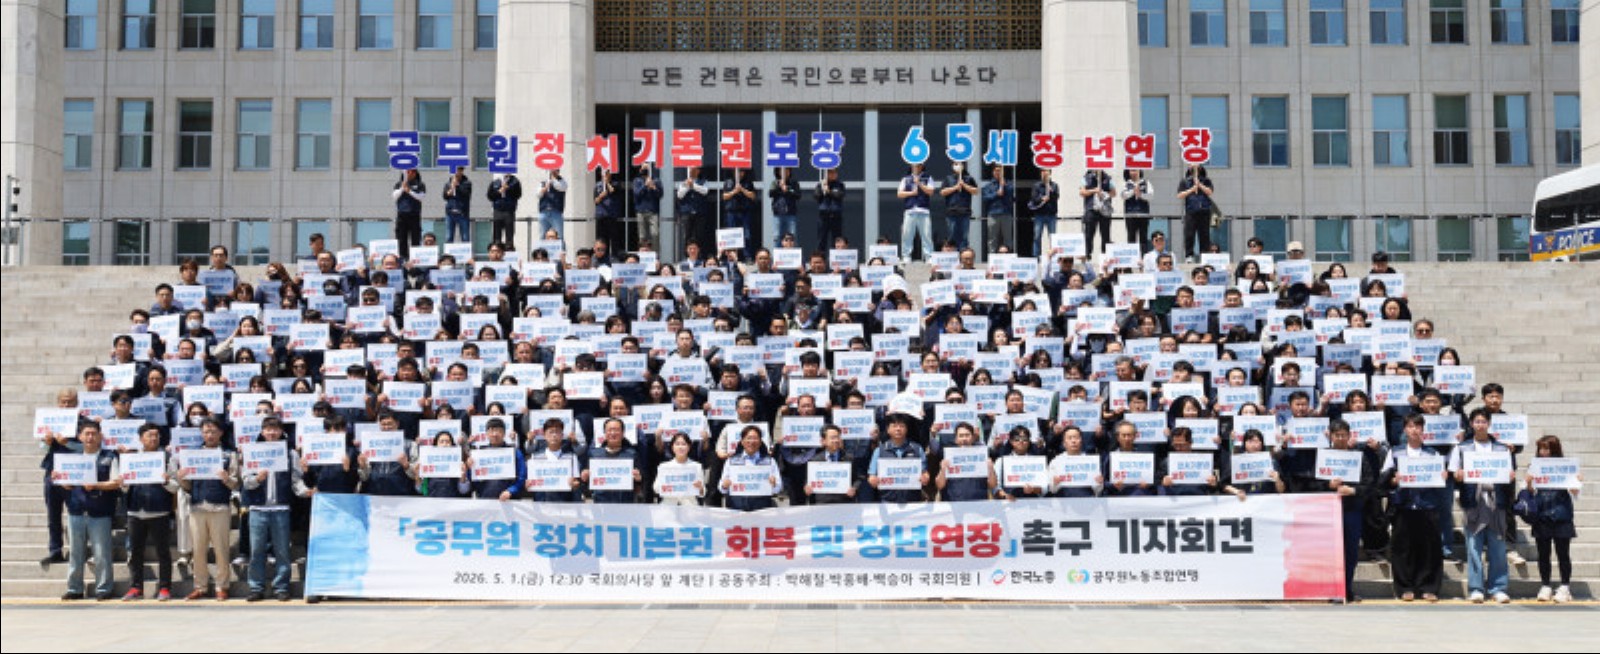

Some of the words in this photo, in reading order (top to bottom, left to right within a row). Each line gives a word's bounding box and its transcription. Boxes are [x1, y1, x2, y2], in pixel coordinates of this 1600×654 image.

[641, 66, 684, 87] 모든
[700, 66, 763, 87] 권력은
[780, 66, 915, 86] 국민으로부터
[931, 64, 998, 86] 나온다
[399, 517, 520, 557] 「공무원
[532, 523, 713, 559] 정치기본권
[725, 525, 797, 559] 회복
[811, 525, 844, 558] 및
[1106, 517, 1254, 554] 기자회견
[453, 571, 488, 585] 2026.
[494, 573, 505, 585] 5.
[549, 574, 584, 586] 12:30
[589, 573, 655, 587] 국회의사당
[660, 573, 674, 588] 앞
[679, 573, 704, 587] 계단
[719, 573, 771, 587] 공동주최
[919, 573, 972, 587] 국회의원
[1011, 569, 1056, 584] 한국노총
[1093, 569, 1199, 583] 공무원노동조합연맹
